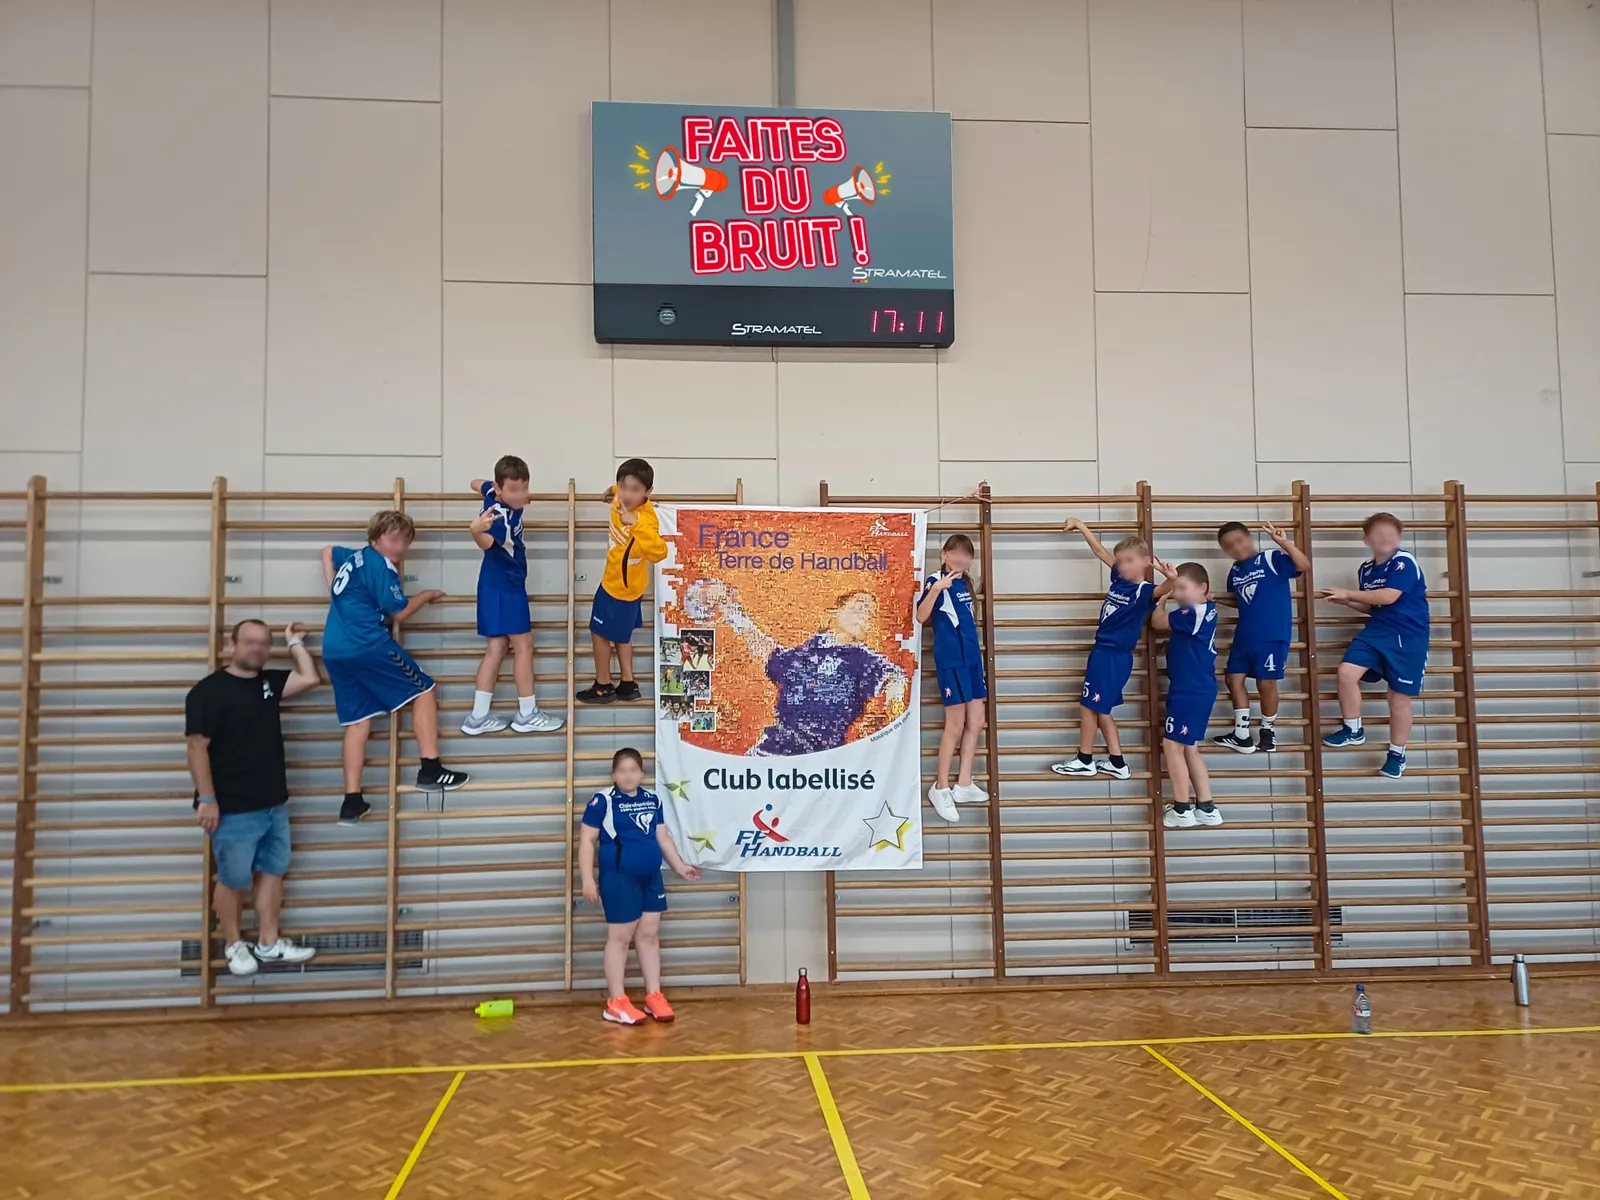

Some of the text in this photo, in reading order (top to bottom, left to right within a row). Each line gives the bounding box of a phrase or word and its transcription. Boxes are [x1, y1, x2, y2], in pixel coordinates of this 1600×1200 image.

[683, 116, 846, 163] FAITES
[740, 166, 811, 215] DU
[691, 216, 870, 274] BRUIT !
[852, 266, 947, 280] STRAMATEL
[731, 322, 822, 335] STRAMATEL
[699, 524, 790, 549] France
[716, 551, 888, 571] Terre de Handball
[1264, 653, 1277, 672] 4
[1082, 681, 1091, 698] 5
[1165, 716, 1175, 733] 6
[703, 766, 876, 791] Club labellisé
[740, 842, 843, 857] HANDBALL
